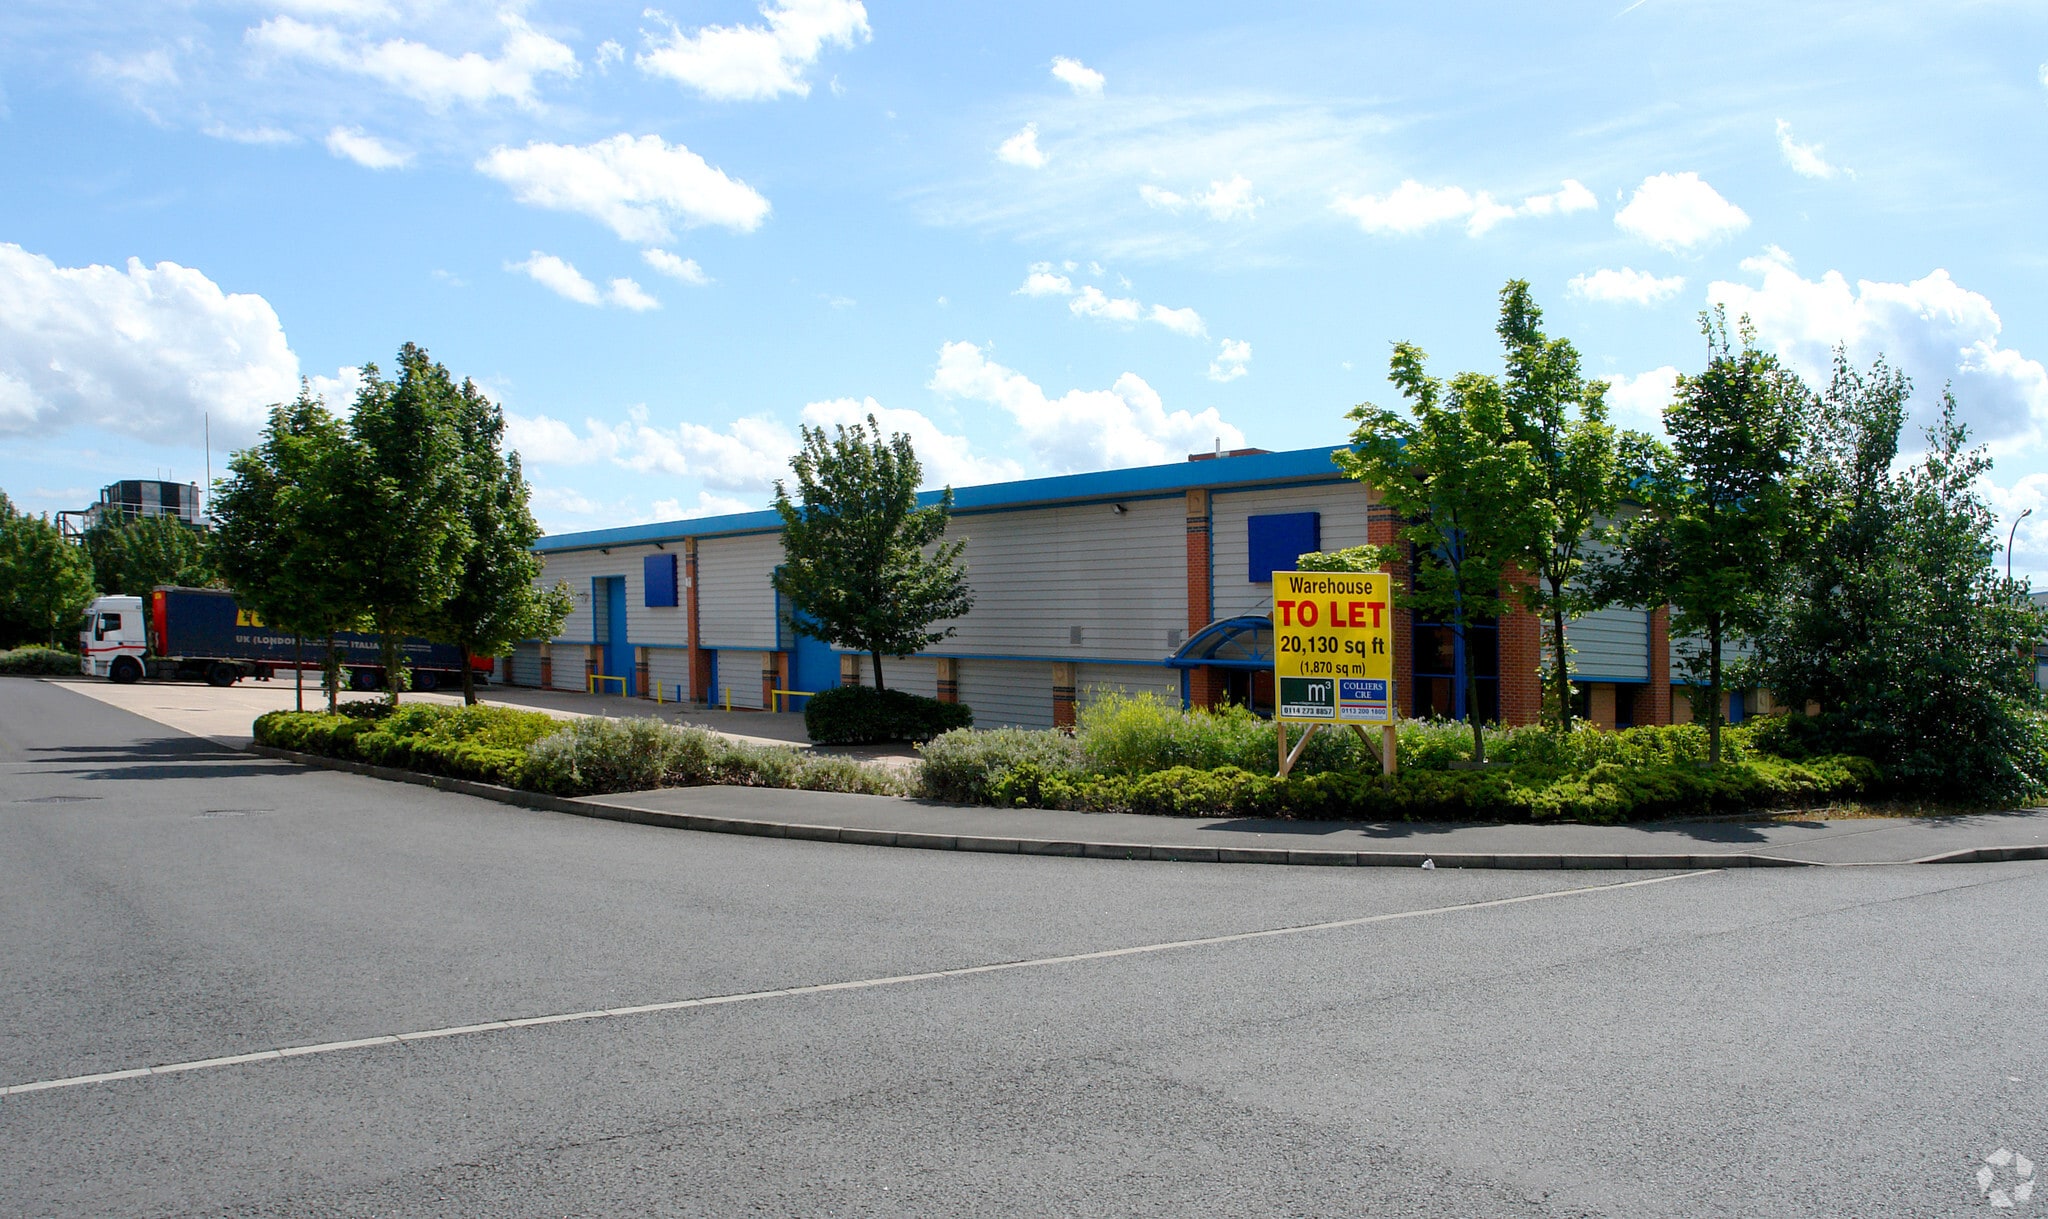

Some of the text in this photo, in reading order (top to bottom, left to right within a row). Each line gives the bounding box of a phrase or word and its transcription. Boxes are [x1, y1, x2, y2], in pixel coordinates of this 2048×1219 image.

[1289, 577, 1373, 595] Warehouse
[1277, 600, 1386, 628] TO LET
[350, 640, 379, 650] ITALIA
[1281, 636, 1385, 658] 20,130 sq ft
[1300, 661, 1366, 677] (1,870 sq m)
[1343, 681, 1383, 690] COLLIERS
[1355, 690, 1372, 699] CRE
[1302, 707, 1314, 715] 273
